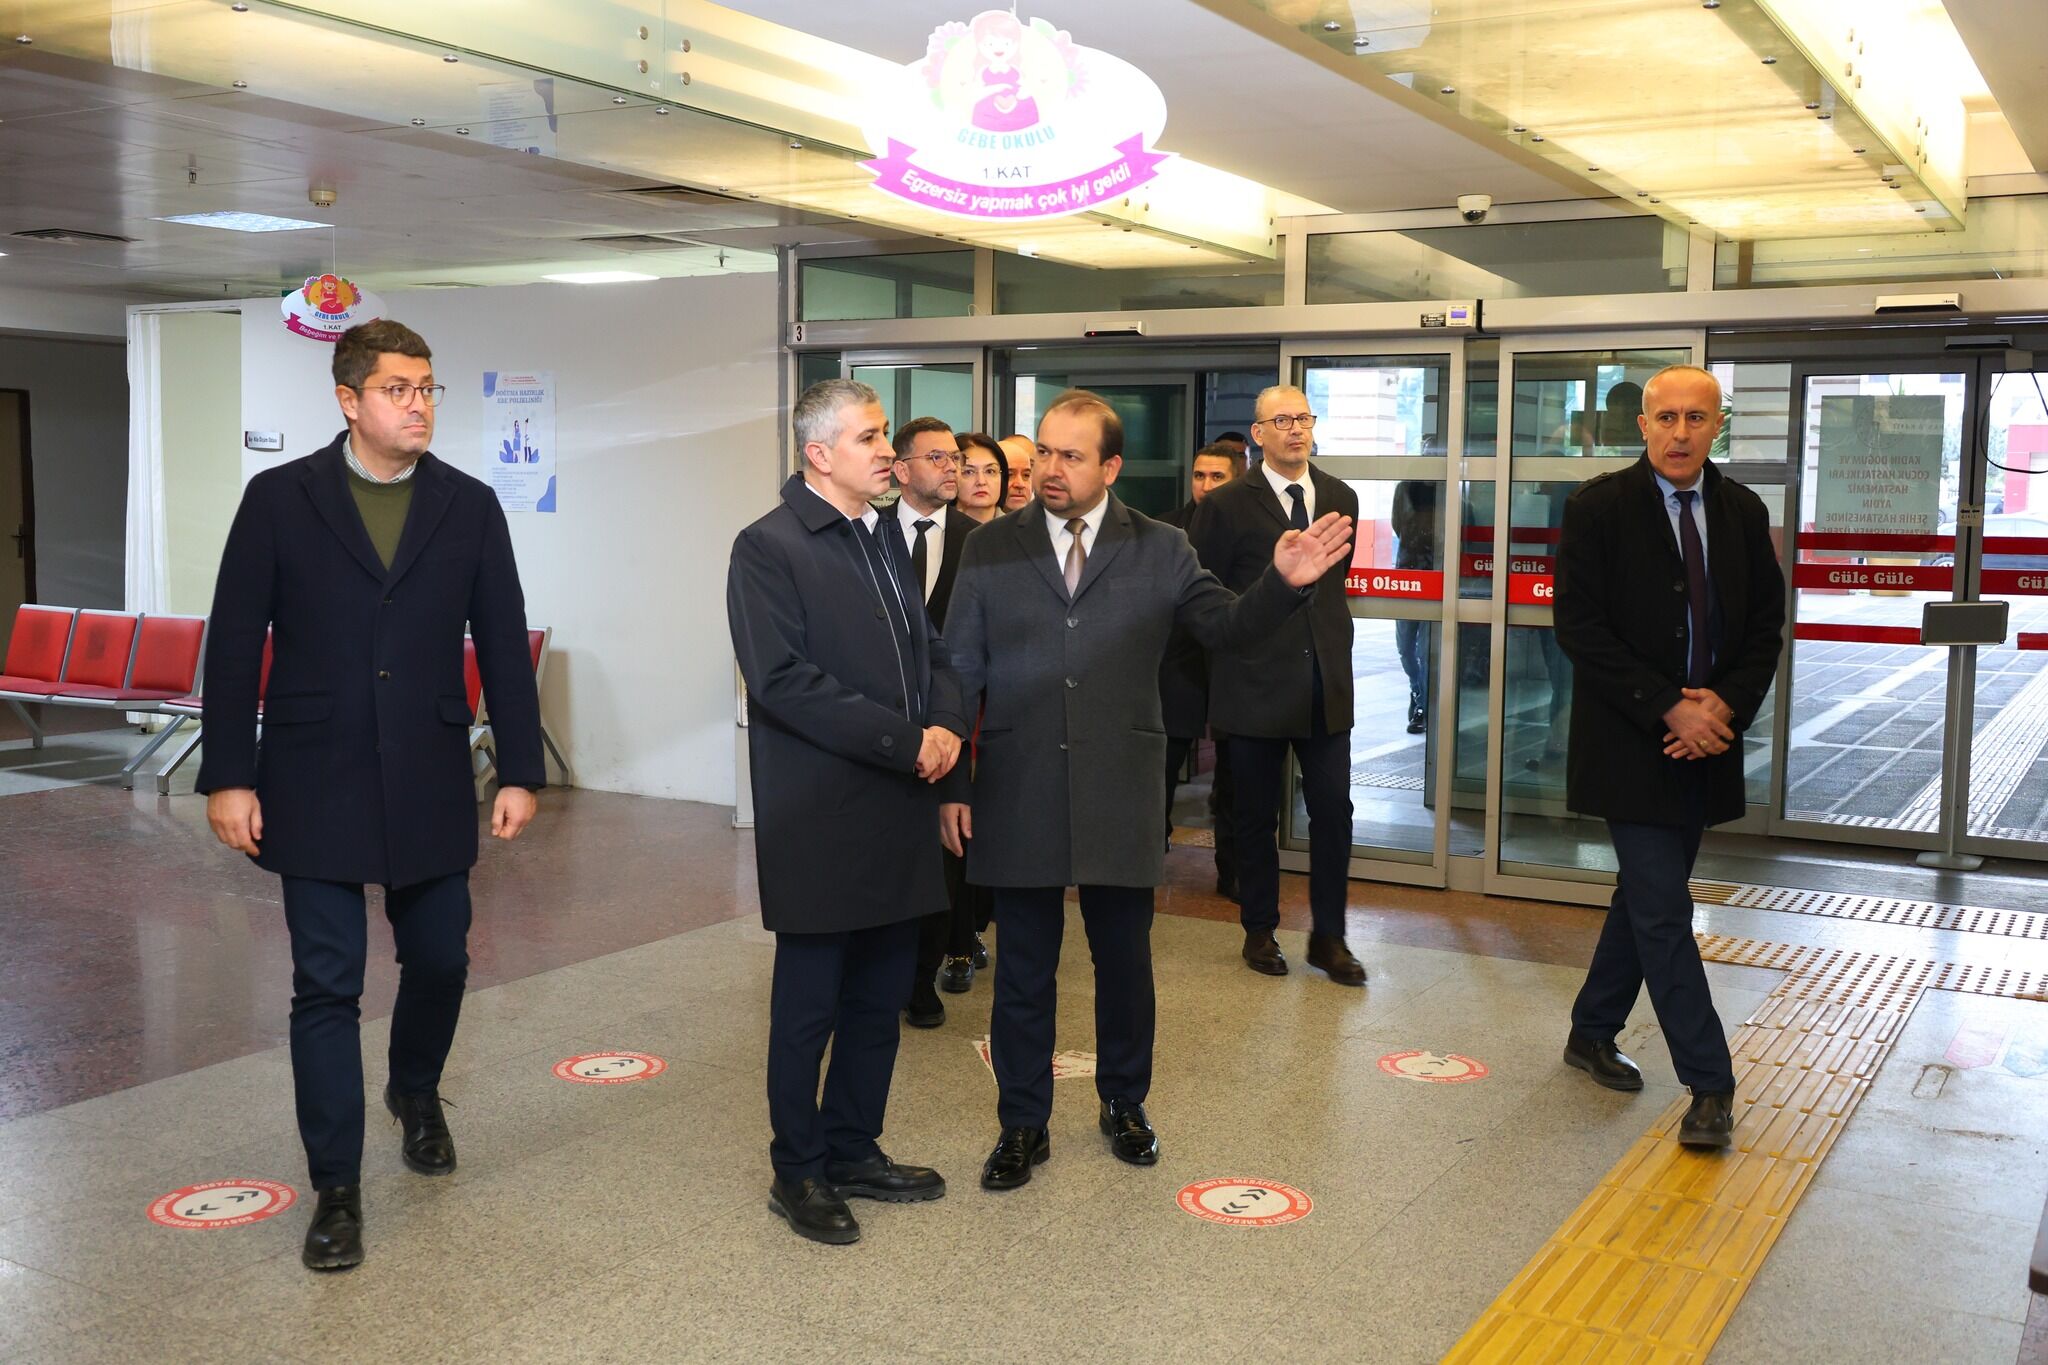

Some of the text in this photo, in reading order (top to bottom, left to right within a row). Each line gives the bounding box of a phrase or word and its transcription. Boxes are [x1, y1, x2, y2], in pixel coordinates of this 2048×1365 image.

[957, 125, 1056, 149] GEBE OKULU
[899, 168, 967, 206] Egzersiz
[967, 190, 1034, 213] yapmak
[1037, 189, 1067, 212] çok
[1094, 161, 1132, 196] geldi
[314, 311, 330, 320] GEBE
[796, 325, 803, 342] 3
[1474, 559, 1546, 573] Gü Güle
[1372, 576, 1422, 592] Olsun
[1828, 570, 1914, 586] Güle Güle
[2017, 576, 2048, 589] Gül
[1533, 583, 1554, 598] Ge
